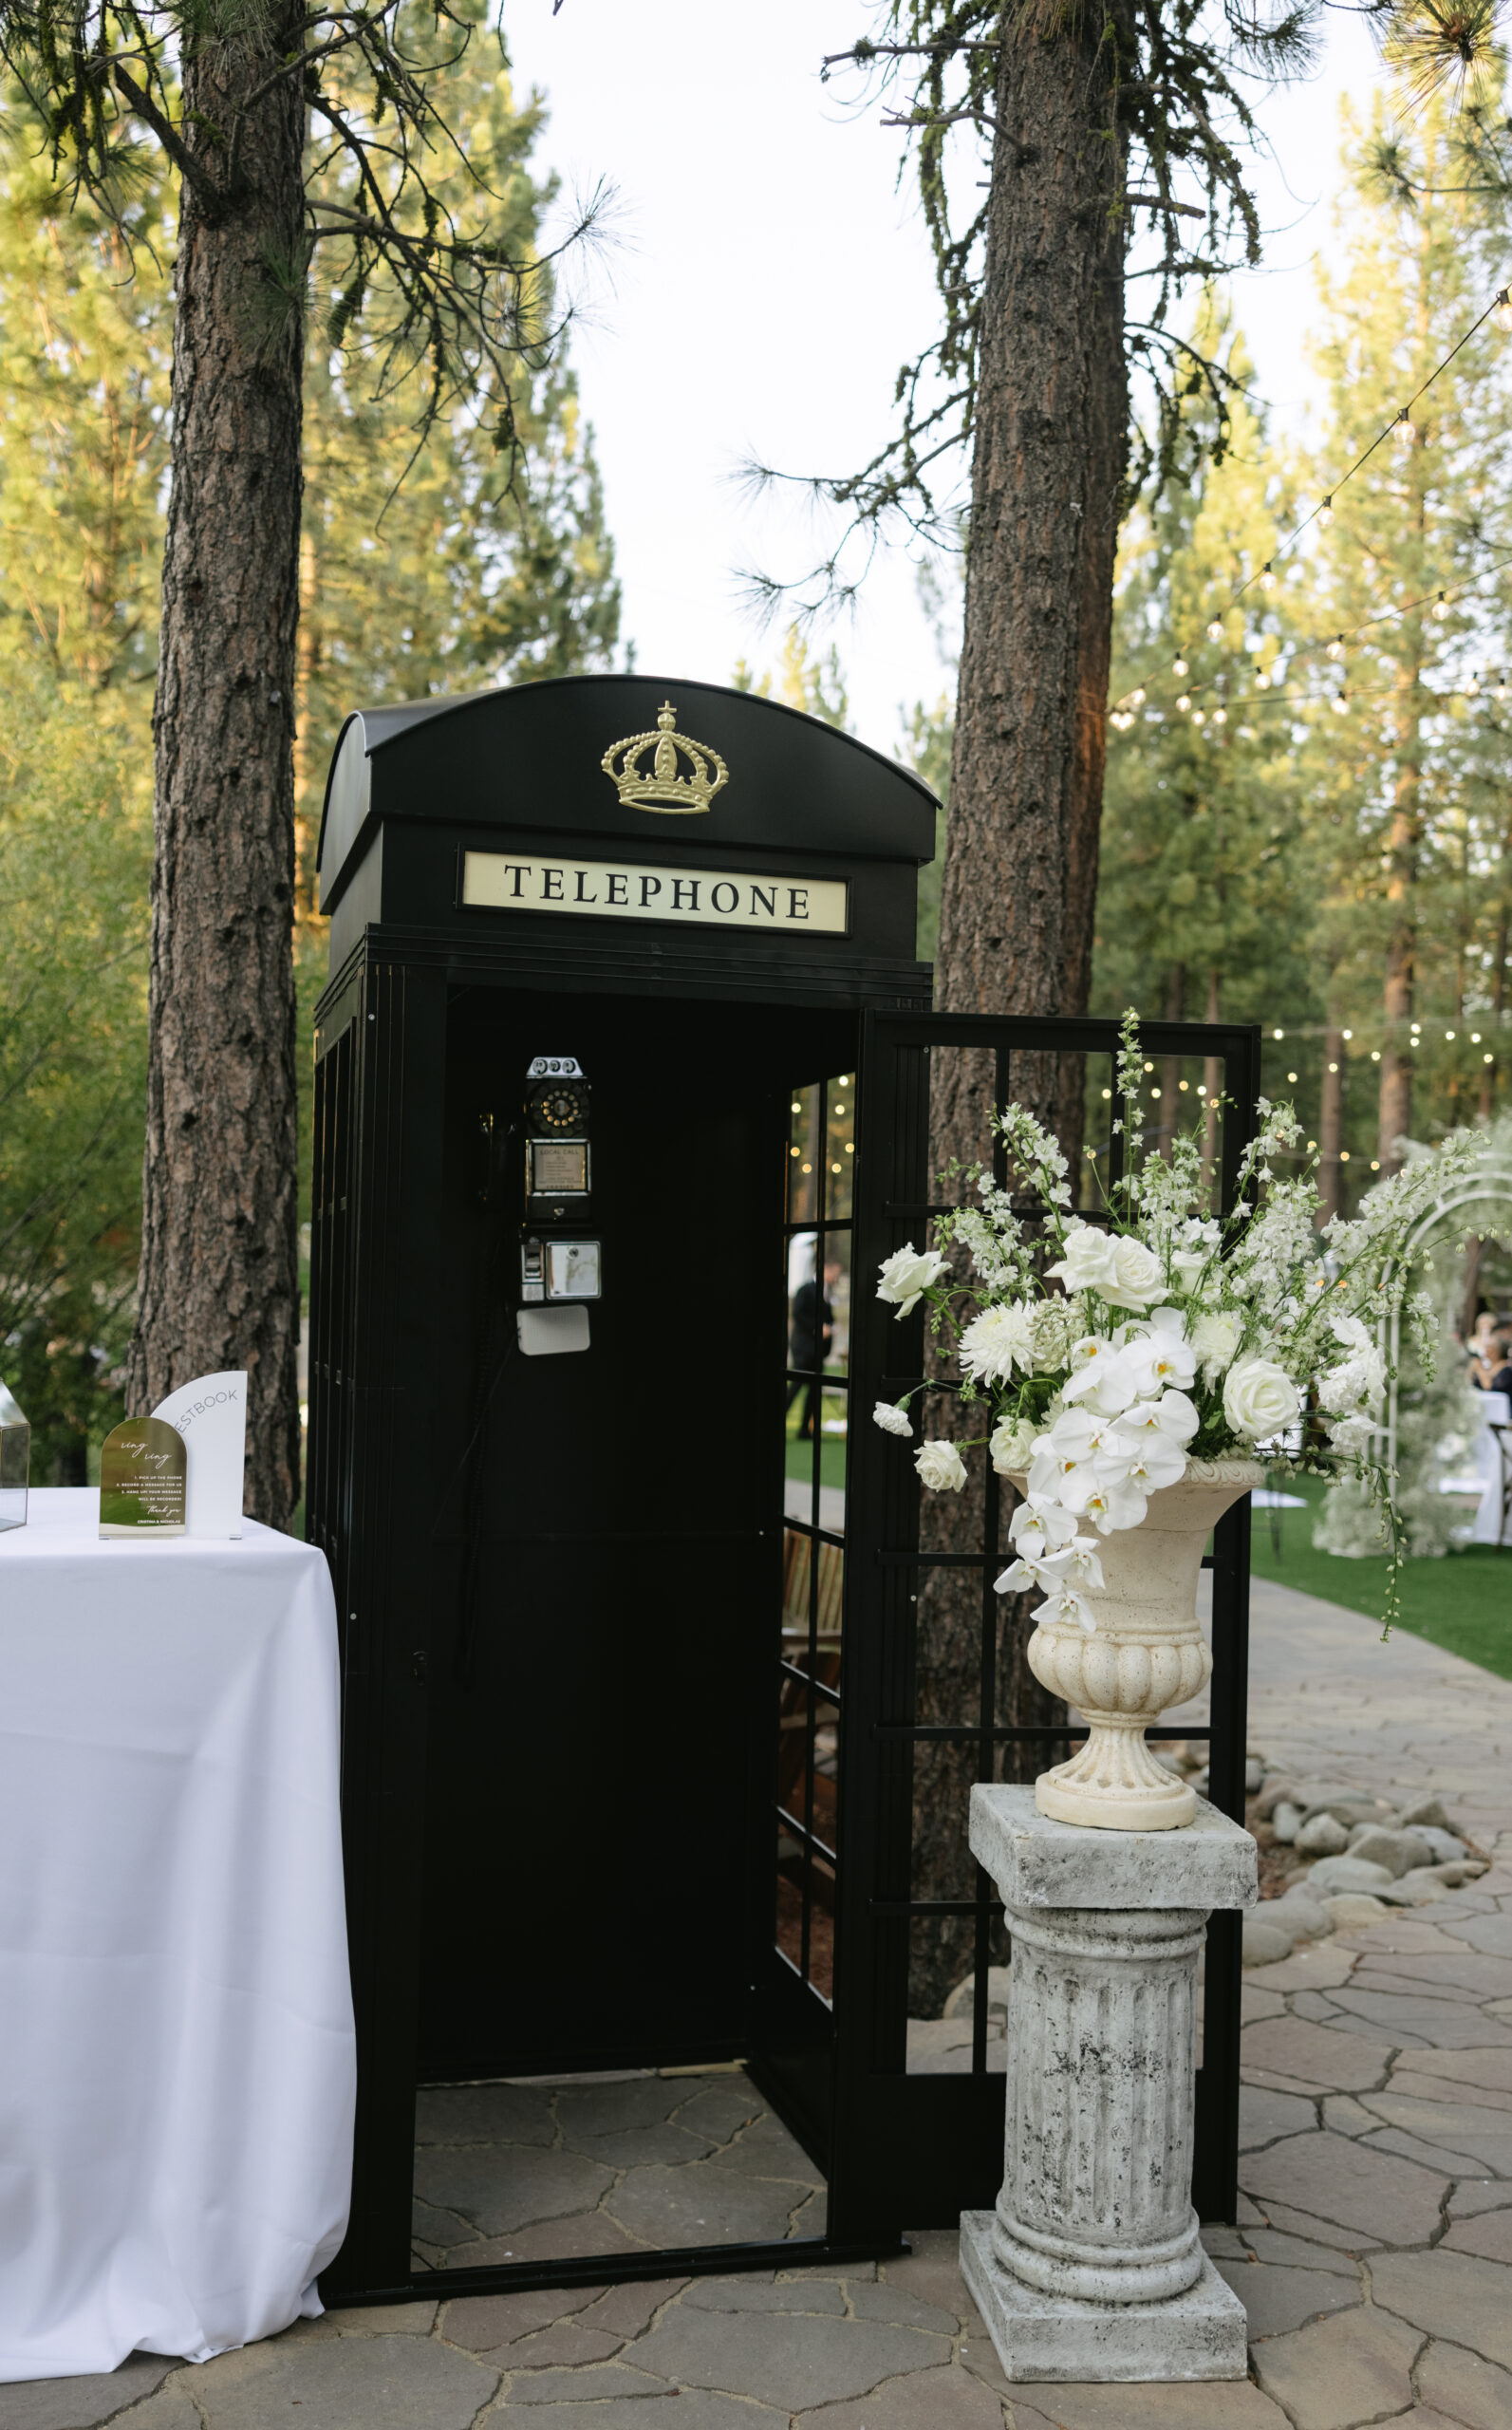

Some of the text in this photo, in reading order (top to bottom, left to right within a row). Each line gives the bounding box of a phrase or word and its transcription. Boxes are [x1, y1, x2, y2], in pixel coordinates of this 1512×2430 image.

[503, 864, 811, 921] TELEPHONE
[174, 1389, 238, 1433] ESTBOOK
[121, 1441, 148, 1458] ring
[144, 1452, 172, 1469] ring
[146, 1505, 182, 1517] Thank you
